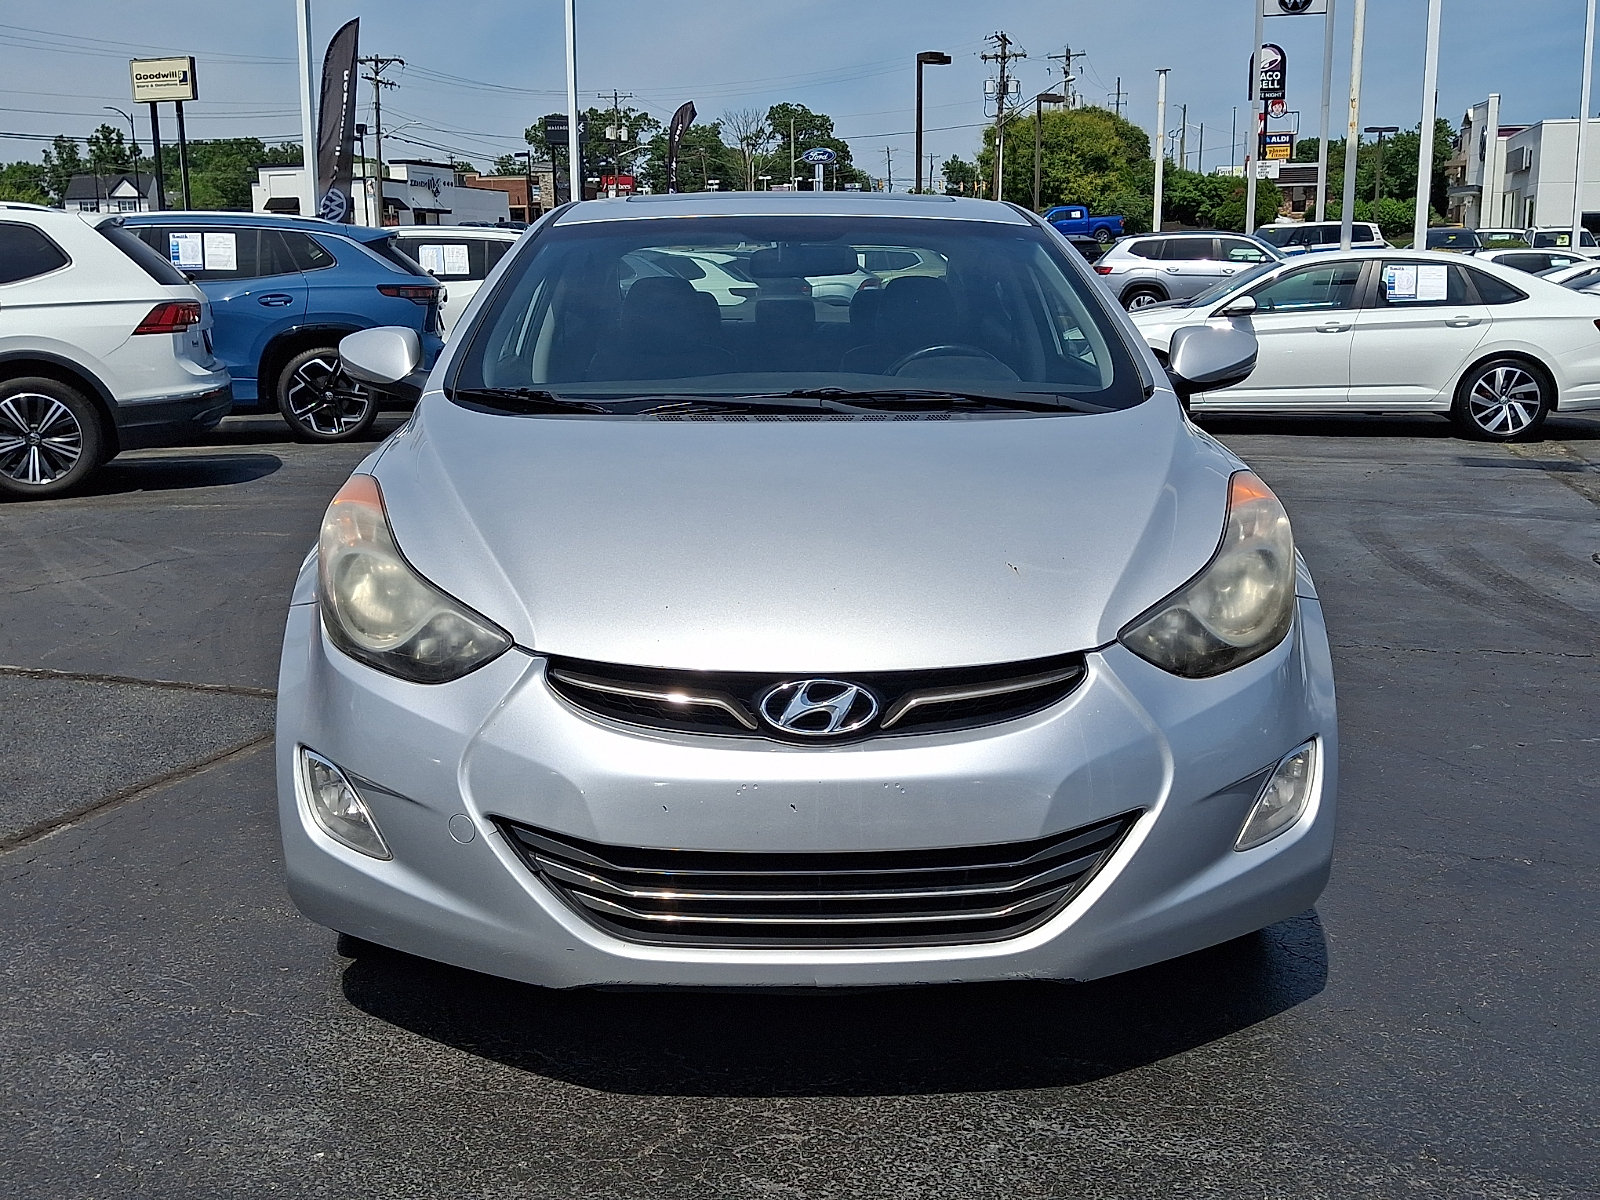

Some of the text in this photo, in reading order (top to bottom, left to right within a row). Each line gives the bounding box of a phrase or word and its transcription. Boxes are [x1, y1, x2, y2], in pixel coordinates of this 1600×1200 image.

[135, 71, 177, 80] Goodwill
[1260, 72, 1281, 80] ACO
[1260, 81, 1280, 89] ELL
[808, 151, 829, 161] Ford
